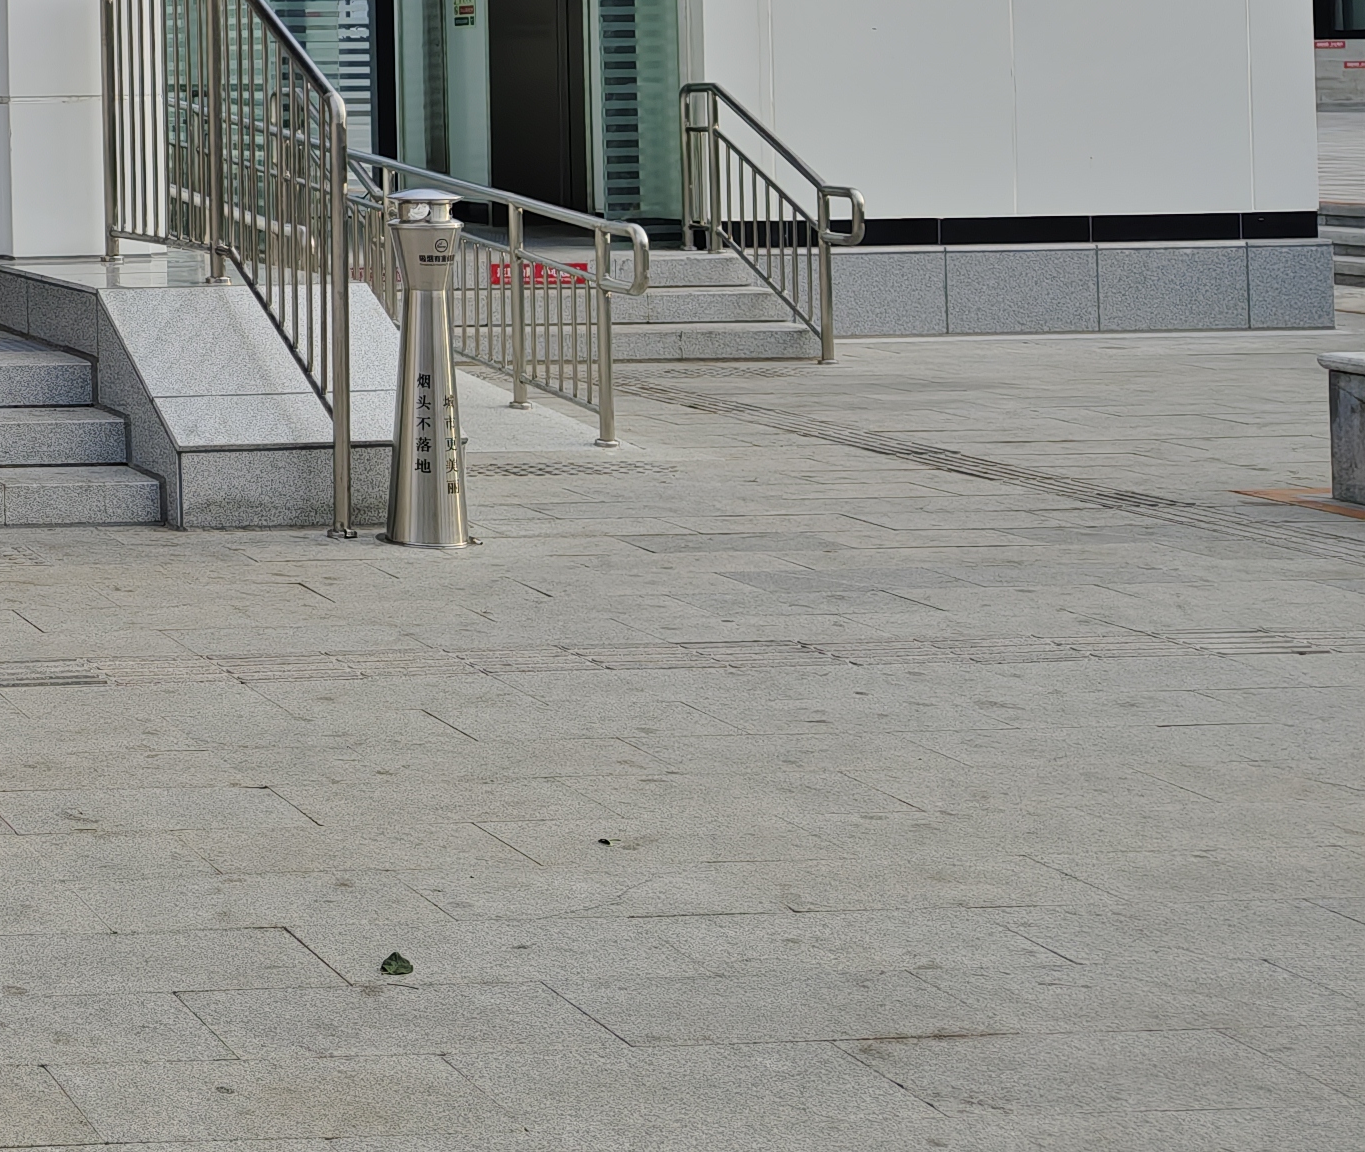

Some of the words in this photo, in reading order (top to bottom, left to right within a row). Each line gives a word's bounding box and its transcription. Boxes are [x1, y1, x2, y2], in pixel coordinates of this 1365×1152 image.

[415, 372, 432, 474] 烟头不落地
